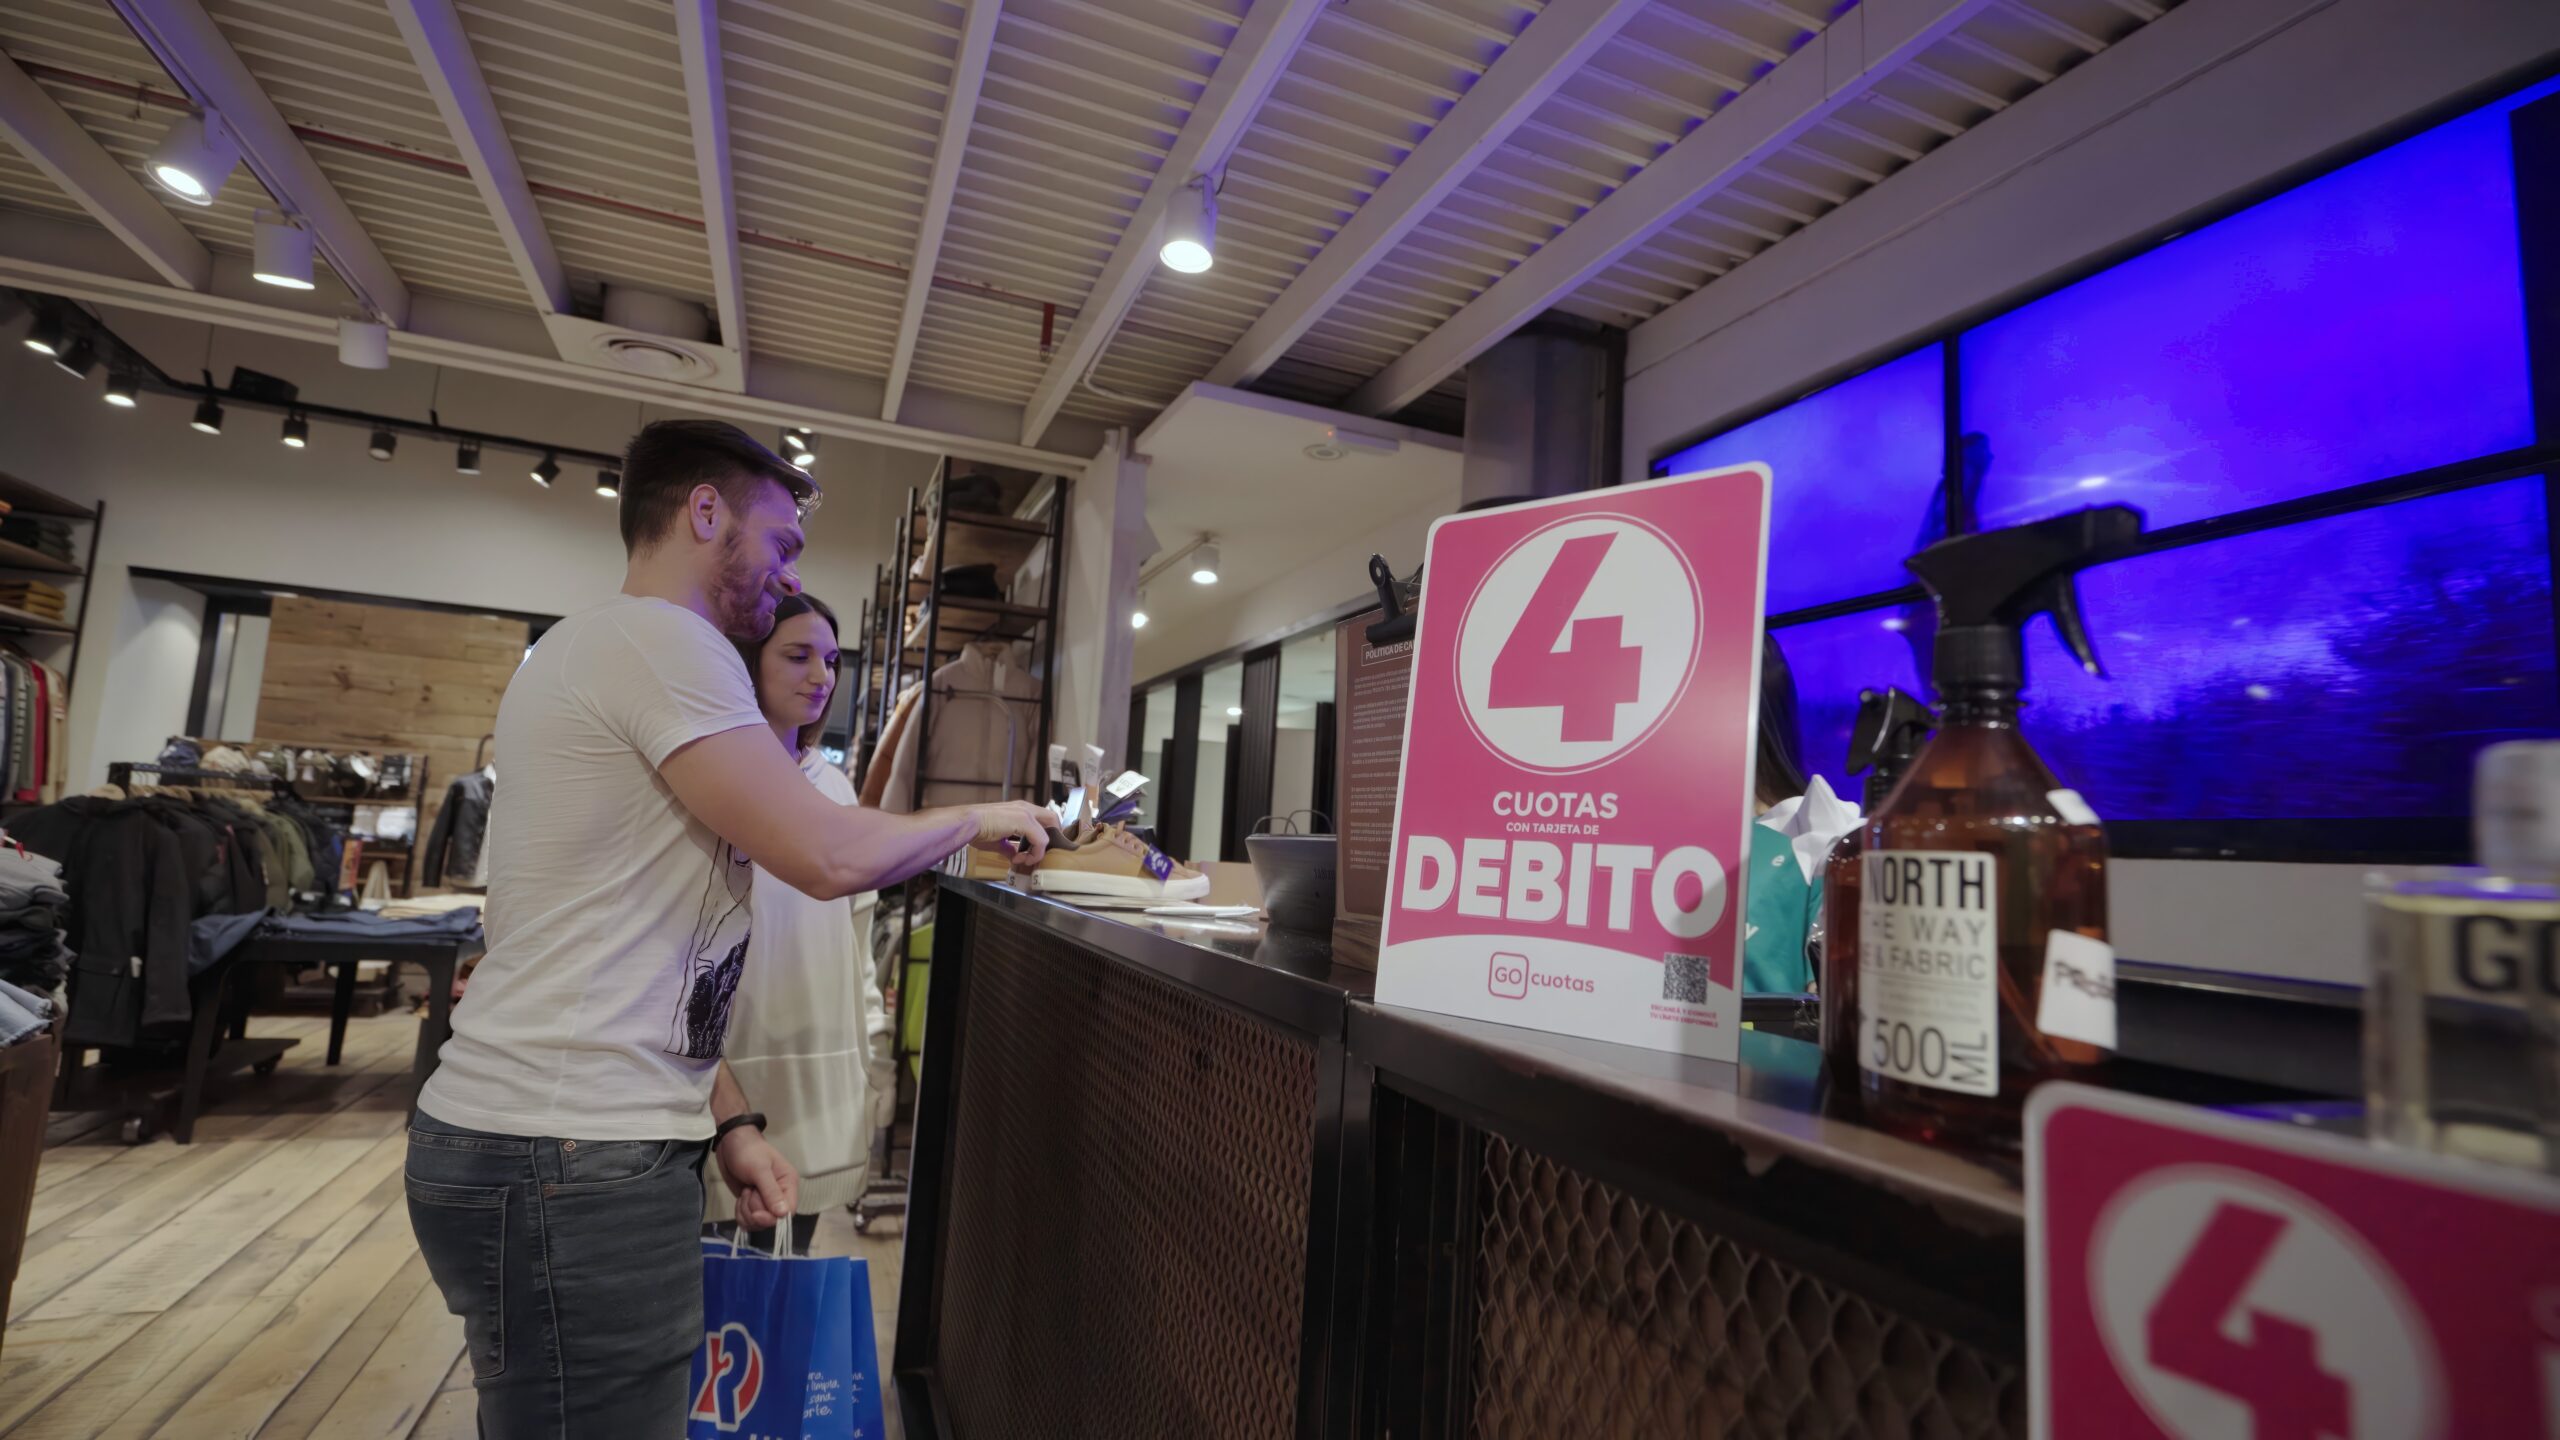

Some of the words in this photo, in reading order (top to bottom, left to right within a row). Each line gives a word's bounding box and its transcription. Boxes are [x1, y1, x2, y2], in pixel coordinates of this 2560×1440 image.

[1403, 639, 1414, 652] CA
[1487, 531, 1644, 743] 4
[1493, 791, 1619, 819] CUOTAS
[1506, 822, 1530, 833] CON
[1533, 823, 1581, 835] TARJETA
[1583, 824, 1600, 835] DE
[1401, 836, 1727, 940] DEBITO
[1868, 856, 1985, 910] NORTH
[1909, 915, 1987, 946] WAY
[1494, 966, 1522, 985] GO
[1531, 972, 1595, 993] cuotas
[1889, 946, 1986, 980] FABRIC
[1873, 1018, 1945, 1079] 500
[1949, 1031, 1987, 1086] ML
[2144, 1198, 2354, 1440] 4
